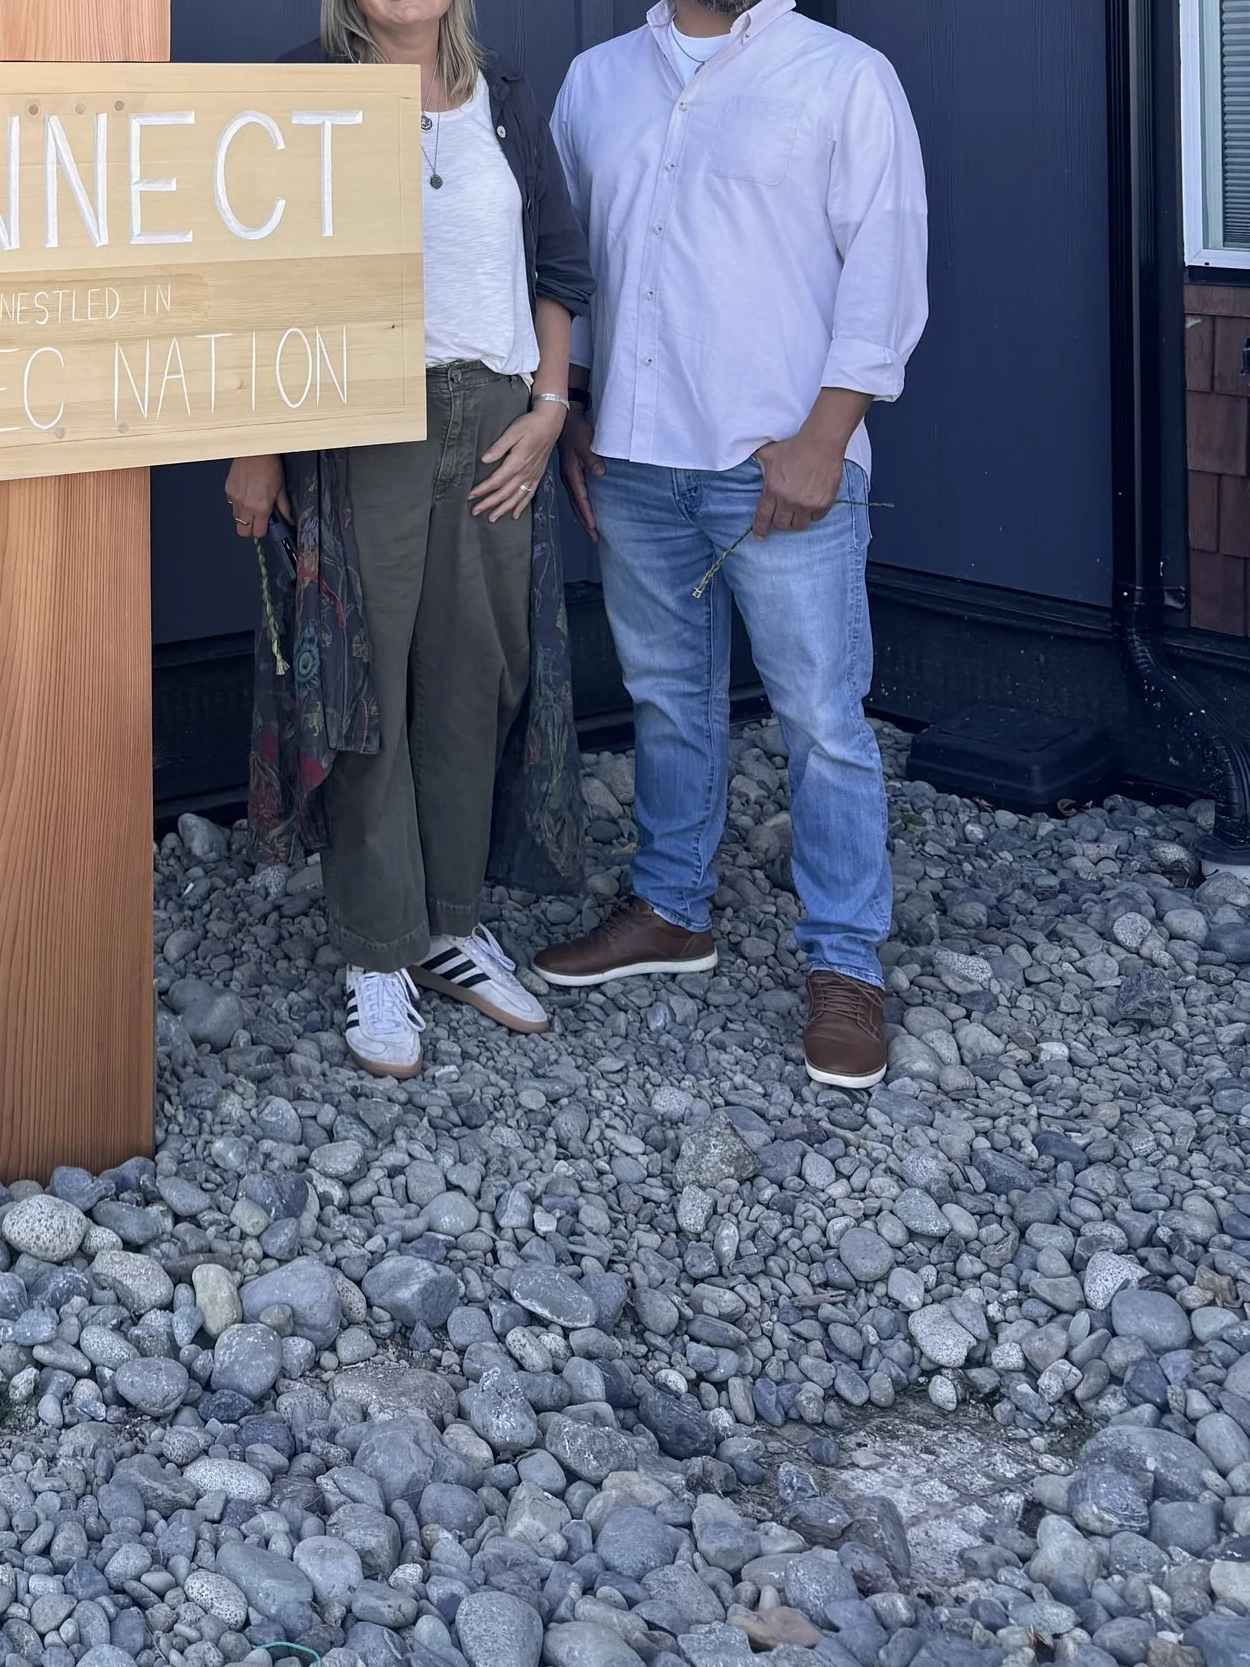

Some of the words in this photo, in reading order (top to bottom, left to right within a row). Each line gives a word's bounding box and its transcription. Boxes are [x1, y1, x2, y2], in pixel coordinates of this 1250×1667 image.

[0, 287, 120, 325] NESTLED
[143, 283, 171, 317] IN
[114, 325, 347, 422] NATION
